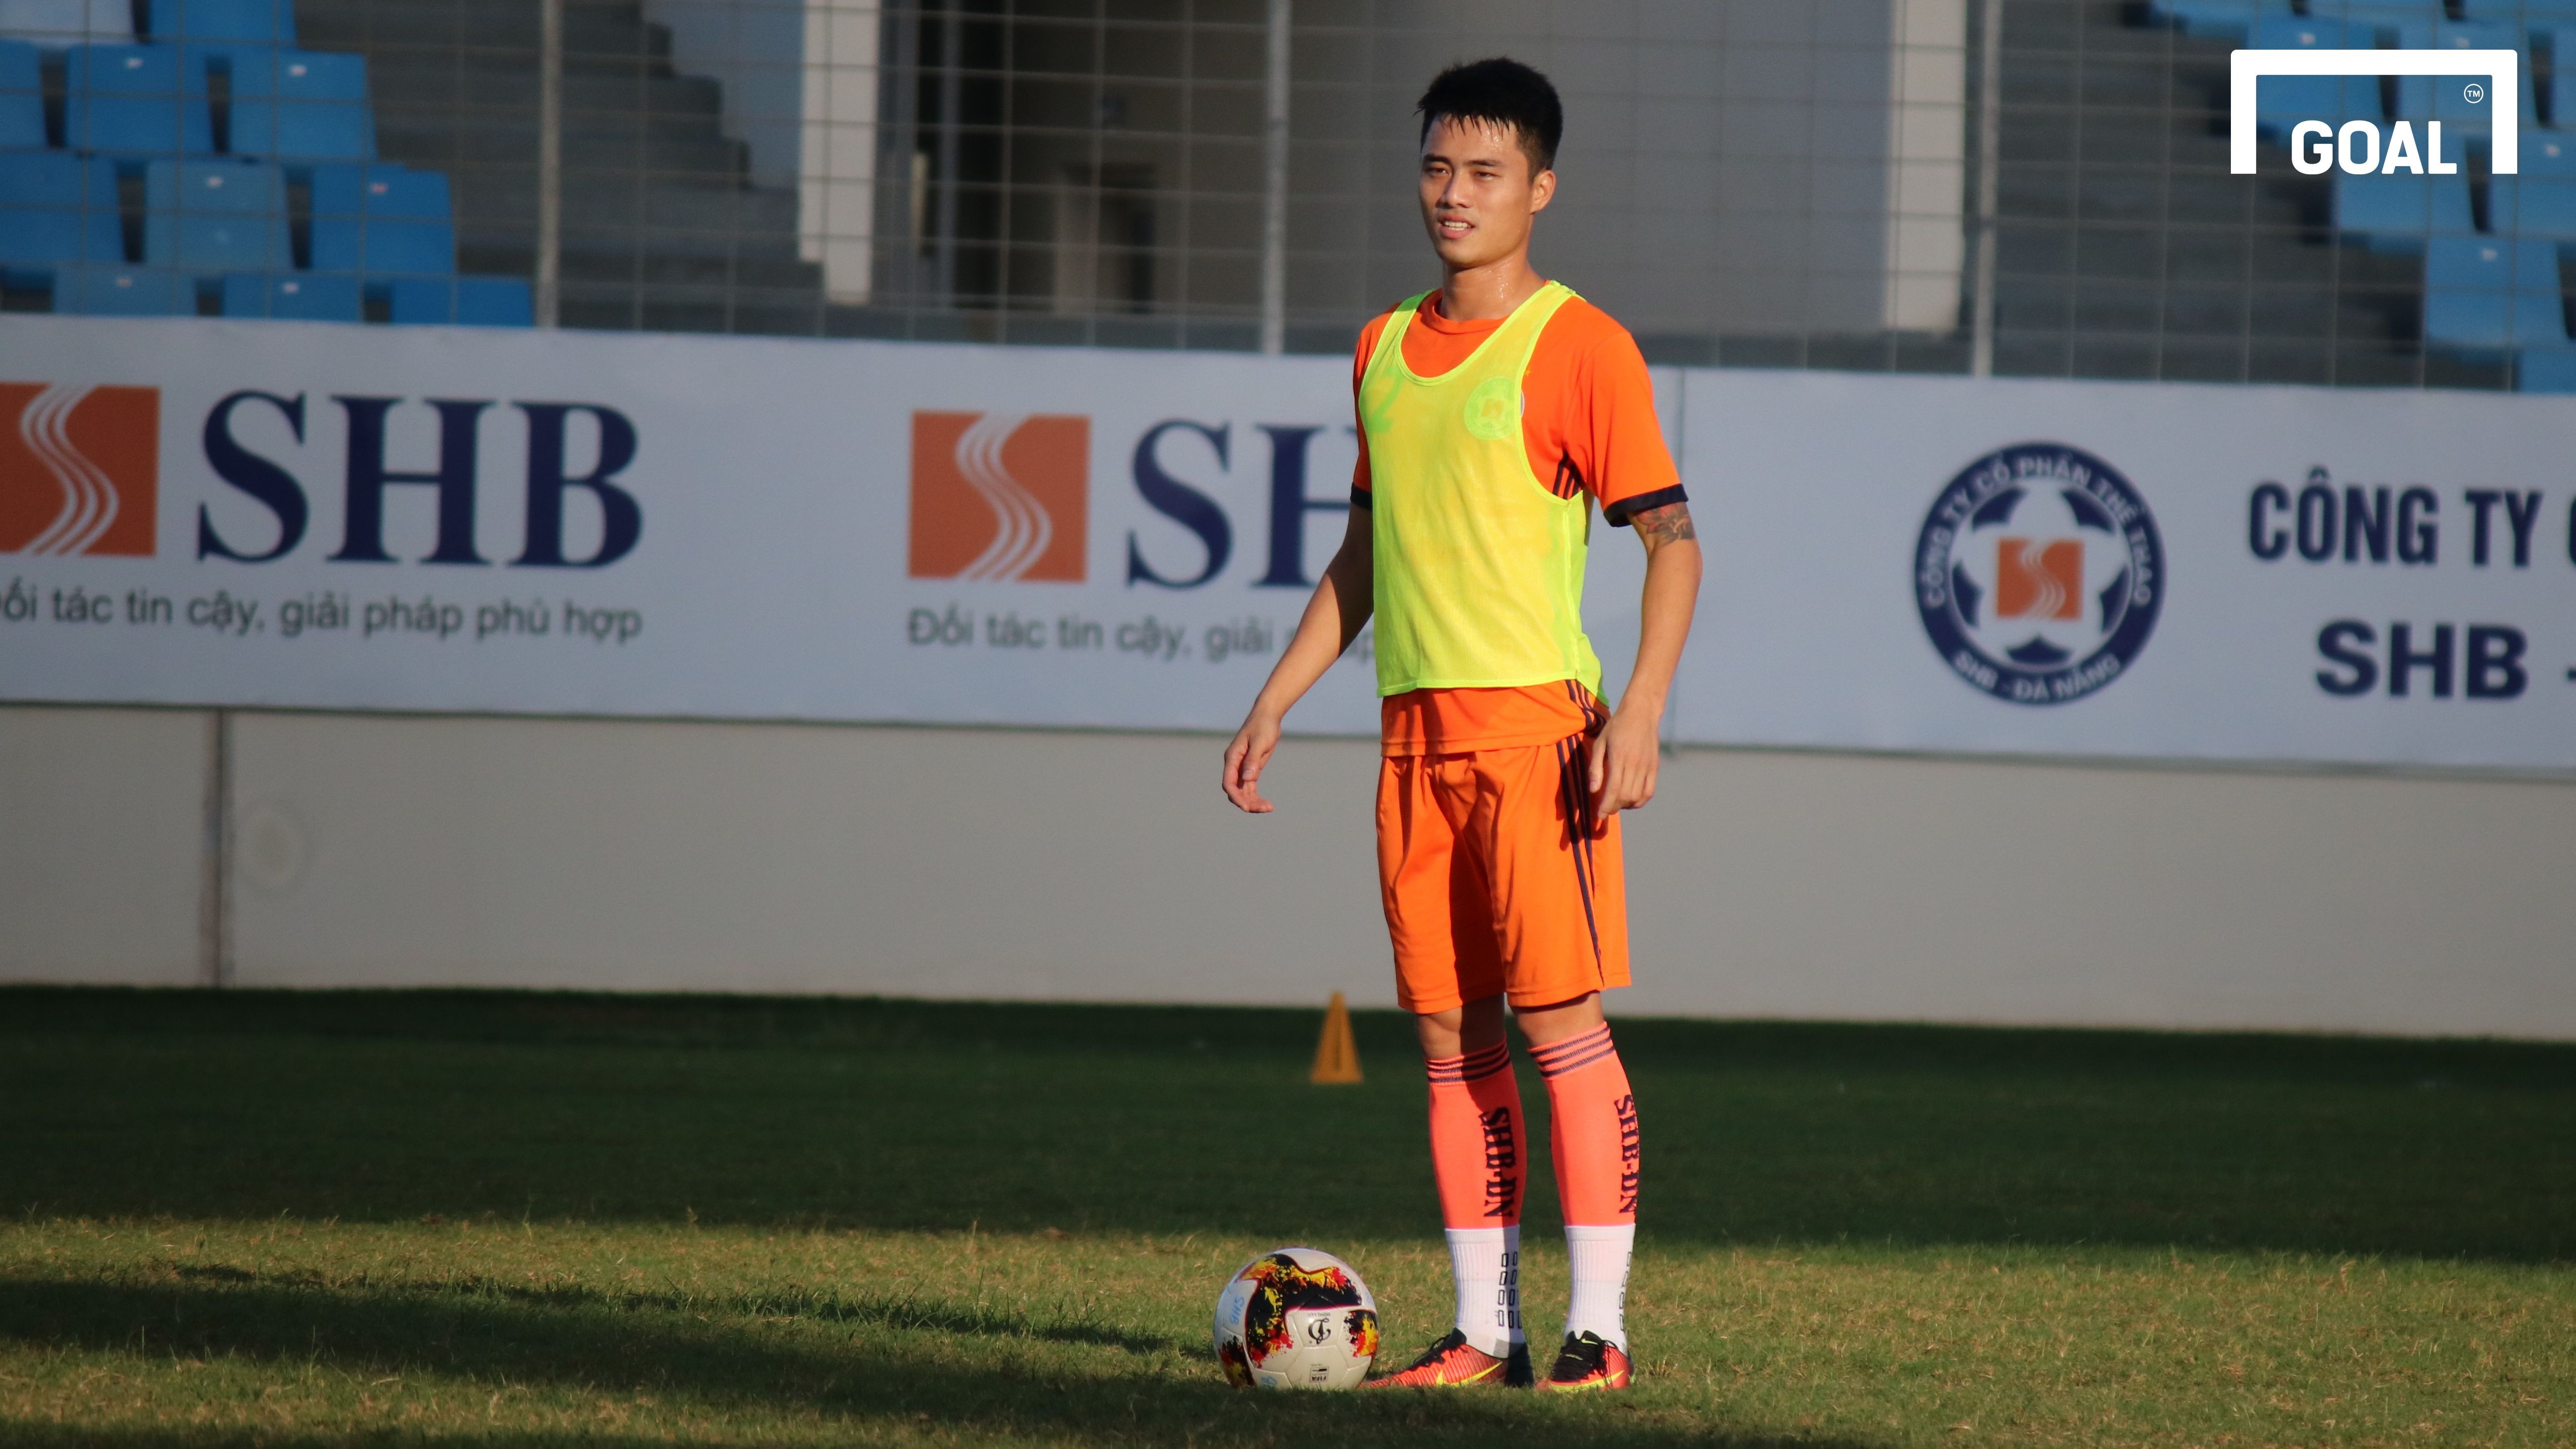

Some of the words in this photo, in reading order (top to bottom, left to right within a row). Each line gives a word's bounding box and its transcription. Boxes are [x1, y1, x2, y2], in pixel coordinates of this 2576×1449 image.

[197, 389, 644, 571] SHB
[1124, 418, 1357, 591] SH
[2248, 464, 2441, 567] CÔNG
[2464, 487, 2544, 569] TY
[0, 575, 38, 623] ối
[53, 584, 114, 624] tác
[126, 585, 173, 625] tin
[186, 589, 266, 638] cậy,
[279, 589, 350, 639] giải
[362, 594, 464, 641] pháp
[475, 597, 551, 643] phù
[563, 599, 644, 645] hợp
[987, 610, 1047, 650] tác
[1058, 612, 1104, 650] tin
[2314, 617, 2529, 701] SHB
[1478, 1106, 1517, 1218] SHB-DN
[1614, 1094, 1639, 1214] SHB-DN
